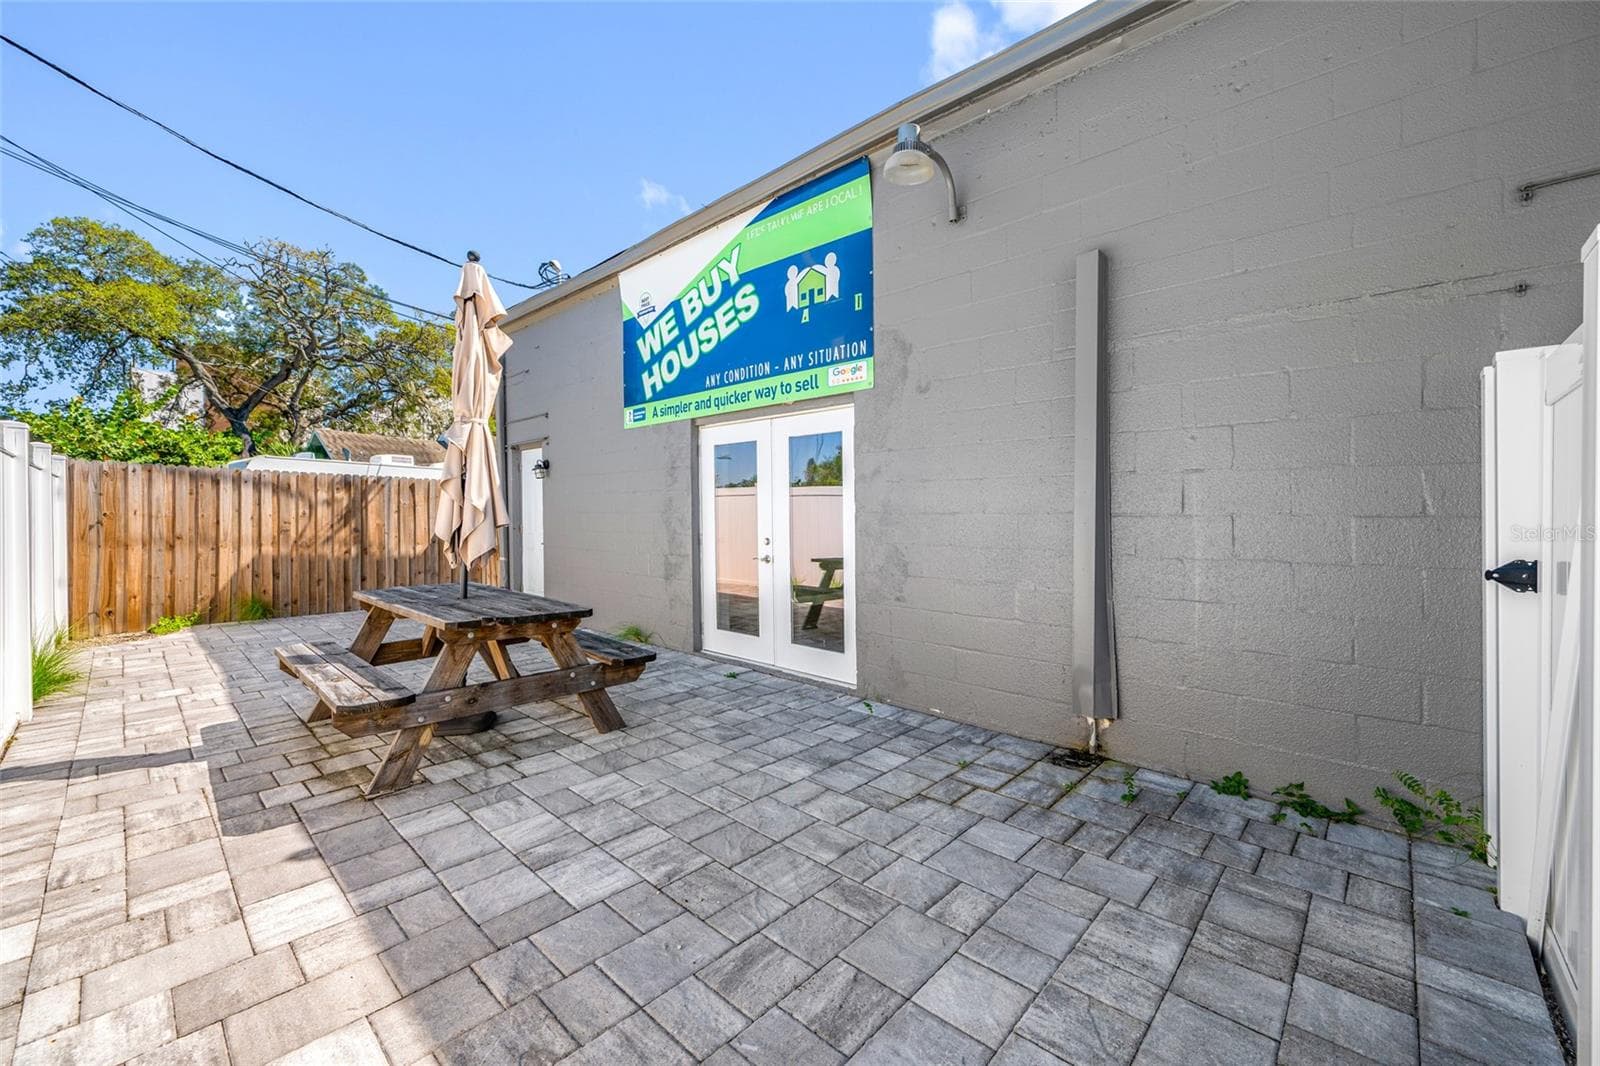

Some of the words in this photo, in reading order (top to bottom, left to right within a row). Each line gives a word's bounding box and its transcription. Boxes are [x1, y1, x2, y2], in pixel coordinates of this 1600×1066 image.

[806, 200, 824, 217] ARE
[636, 308, 680, 364] WE
[680, 243, 741, 327] BUY
[641, 283, 760, 400] HOUSES
[705, 371, 721, 388] ANY
[724, 361, 771, 386] CONDITION
[784, 353, 804, 371] ANY
[808, 340, 867, 366] SITUATION
[832, 363, 863, 377] Google
[651, 406, 659, 418] A
[659, 401, 694, 418] simpler
[694, 395, 711, 411] and
[713, 389, 753, 411] quicker
[754, 384, 777, 401] way
[780, 381, 792, 395] to
[795, 374, 819, 393] sell
